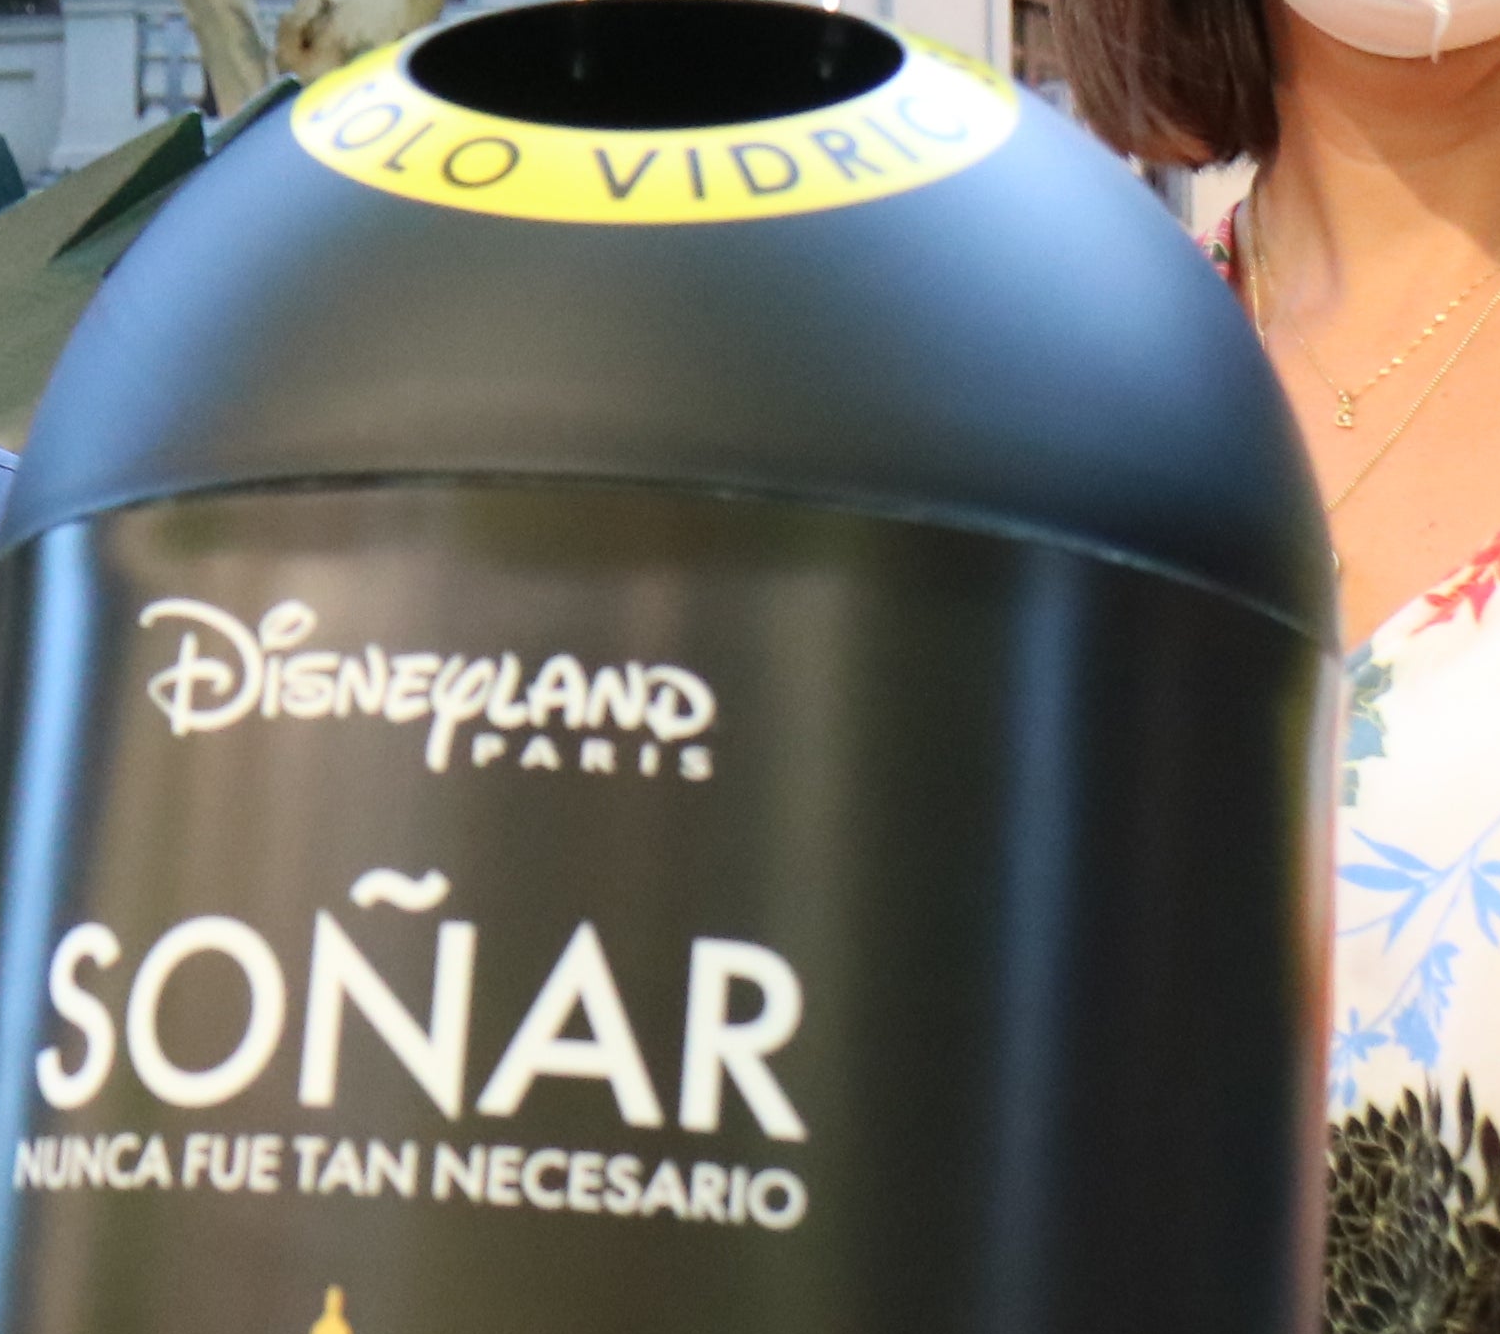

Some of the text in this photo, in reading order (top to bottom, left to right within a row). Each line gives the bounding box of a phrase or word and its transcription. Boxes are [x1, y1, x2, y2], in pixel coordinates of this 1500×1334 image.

[310, 81, 519, 189] SOLO
[471, 733, 714, 781] PARIS
[35, 868, 808, 1143] SOÑAR
[13, 1133, 808, 1231] NUNCA FUE TAN NECESARIO
